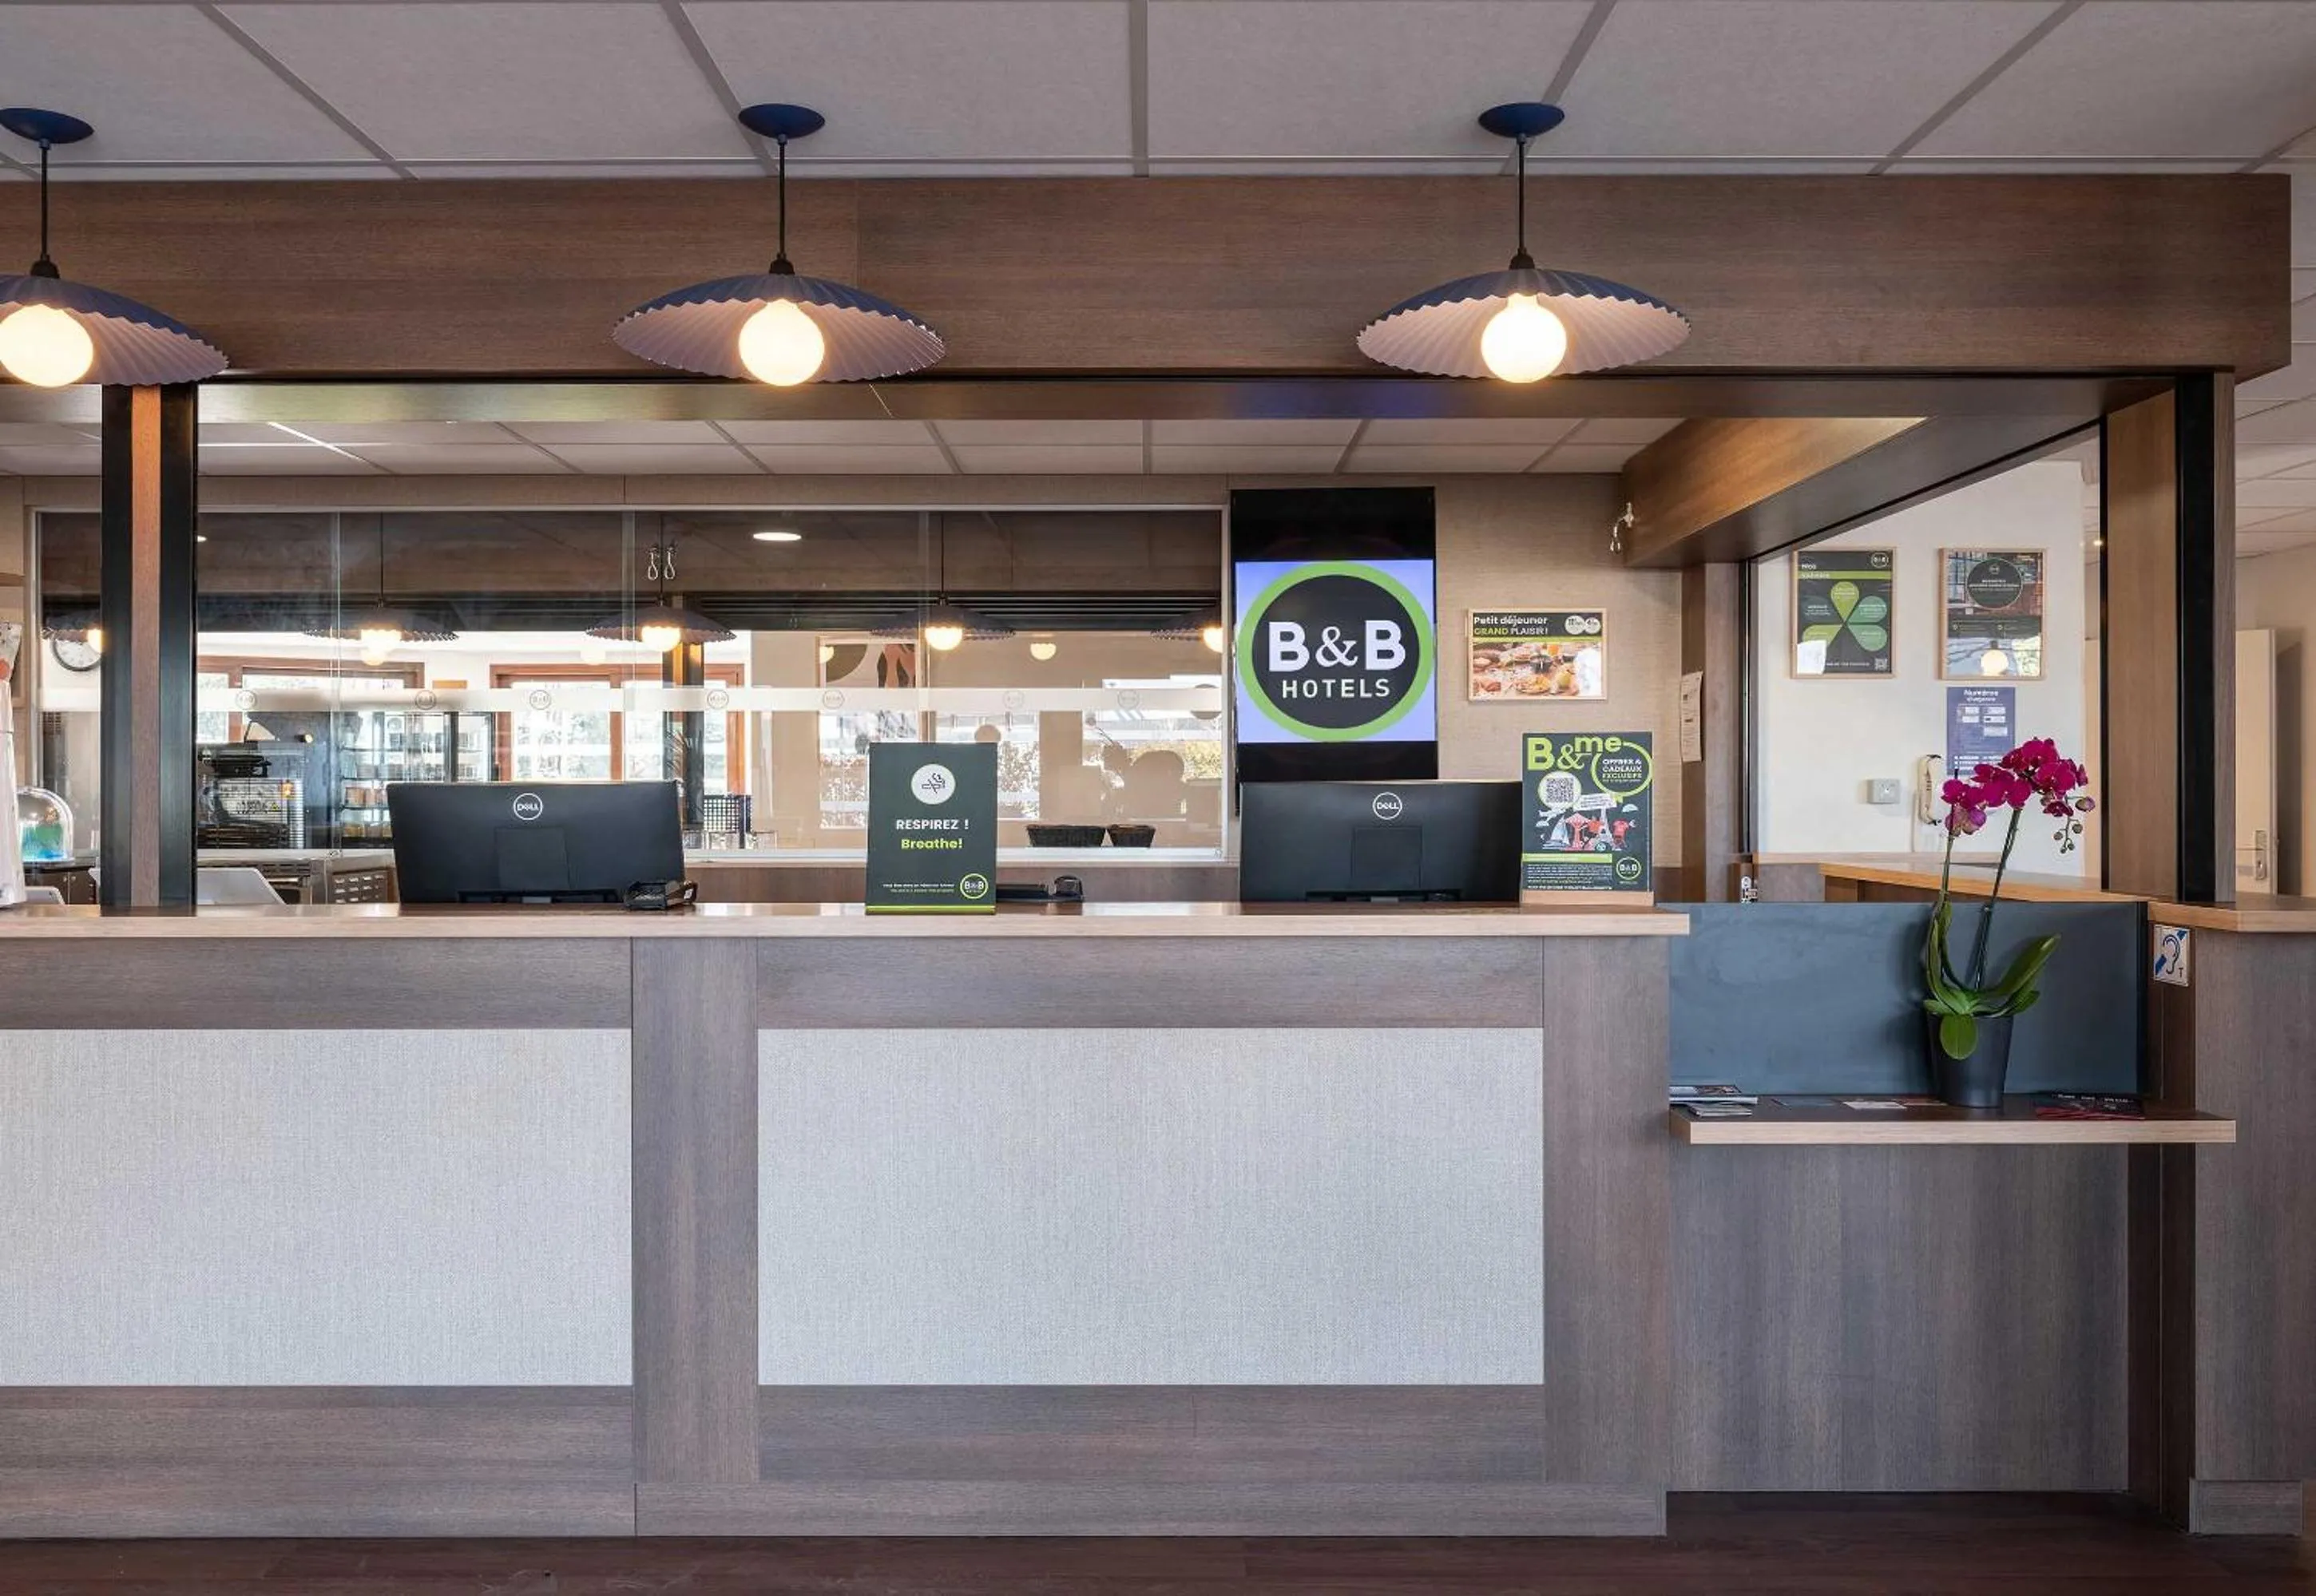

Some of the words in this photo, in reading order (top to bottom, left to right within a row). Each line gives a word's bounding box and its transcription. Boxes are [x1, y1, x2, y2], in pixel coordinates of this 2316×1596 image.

[1473, 615, 1498, 625] Petit
[1500, 615, 1548, 628] déjeuner
[1268, 620, 1406, 671] B&B
[1282, 679, 1390, 699] HOTELS
[895, 819, 959, 830] RESPIREZ
[901, 838, 963, 850] Breathe!
[2179, 967, 2184, 978] T
